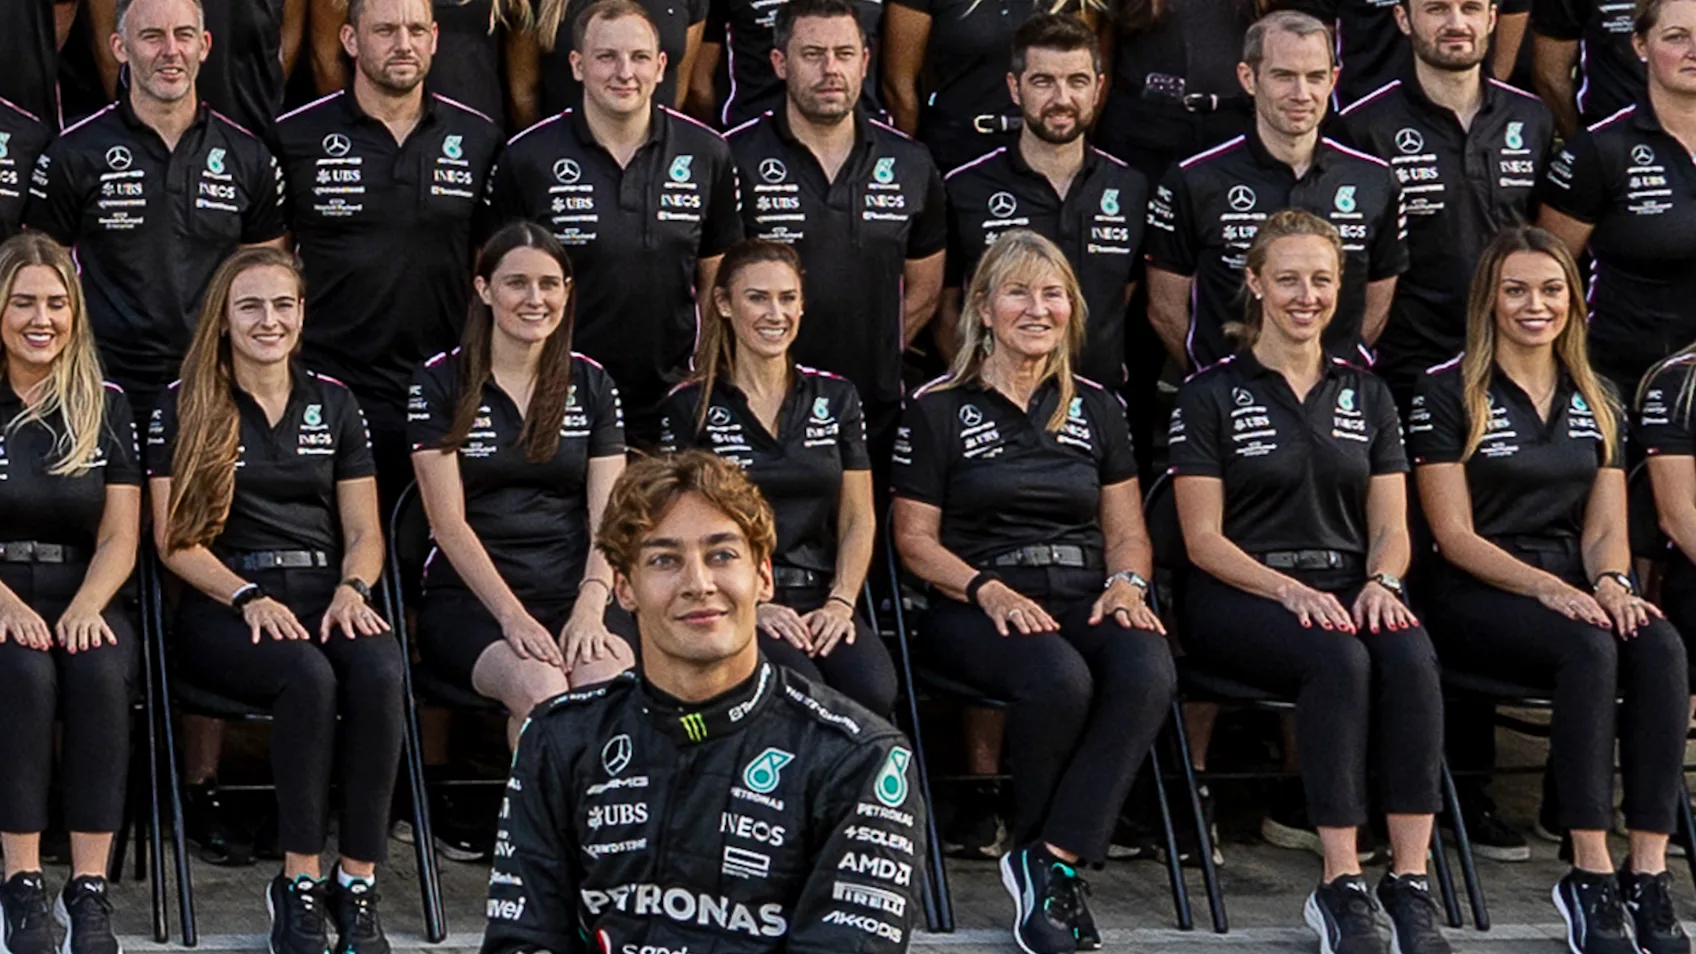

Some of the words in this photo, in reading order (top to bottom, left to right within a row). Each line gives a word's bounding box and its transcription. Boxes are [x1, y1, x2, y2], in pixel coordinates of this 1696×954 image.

[332, 169, 361, 182] UBS
[433, 170, 473, 185] INEOS
[1410, 166, 1439, 180] UBS
[117, 182, 143, 196] UBS
[199, 182, 235, 199] INEOS
[565, 197, 593, 210] UBS
[661, 194, 701, 209] INEOS
[773, 196, 800, 209] UBS
[865, 194, 905, 208] INEOS
[1091, 227, 1129, 242] INEOS
[603, 802, 649, 825] UBS
[856, 802, 913, 828] PETRONAS
[719, 811, 786, 847] INEOS
[856, 827, 914, 856] SOLERA
[838, 851, 896, 879] AMD
[832, 881, 907, 917] PIRELLI
